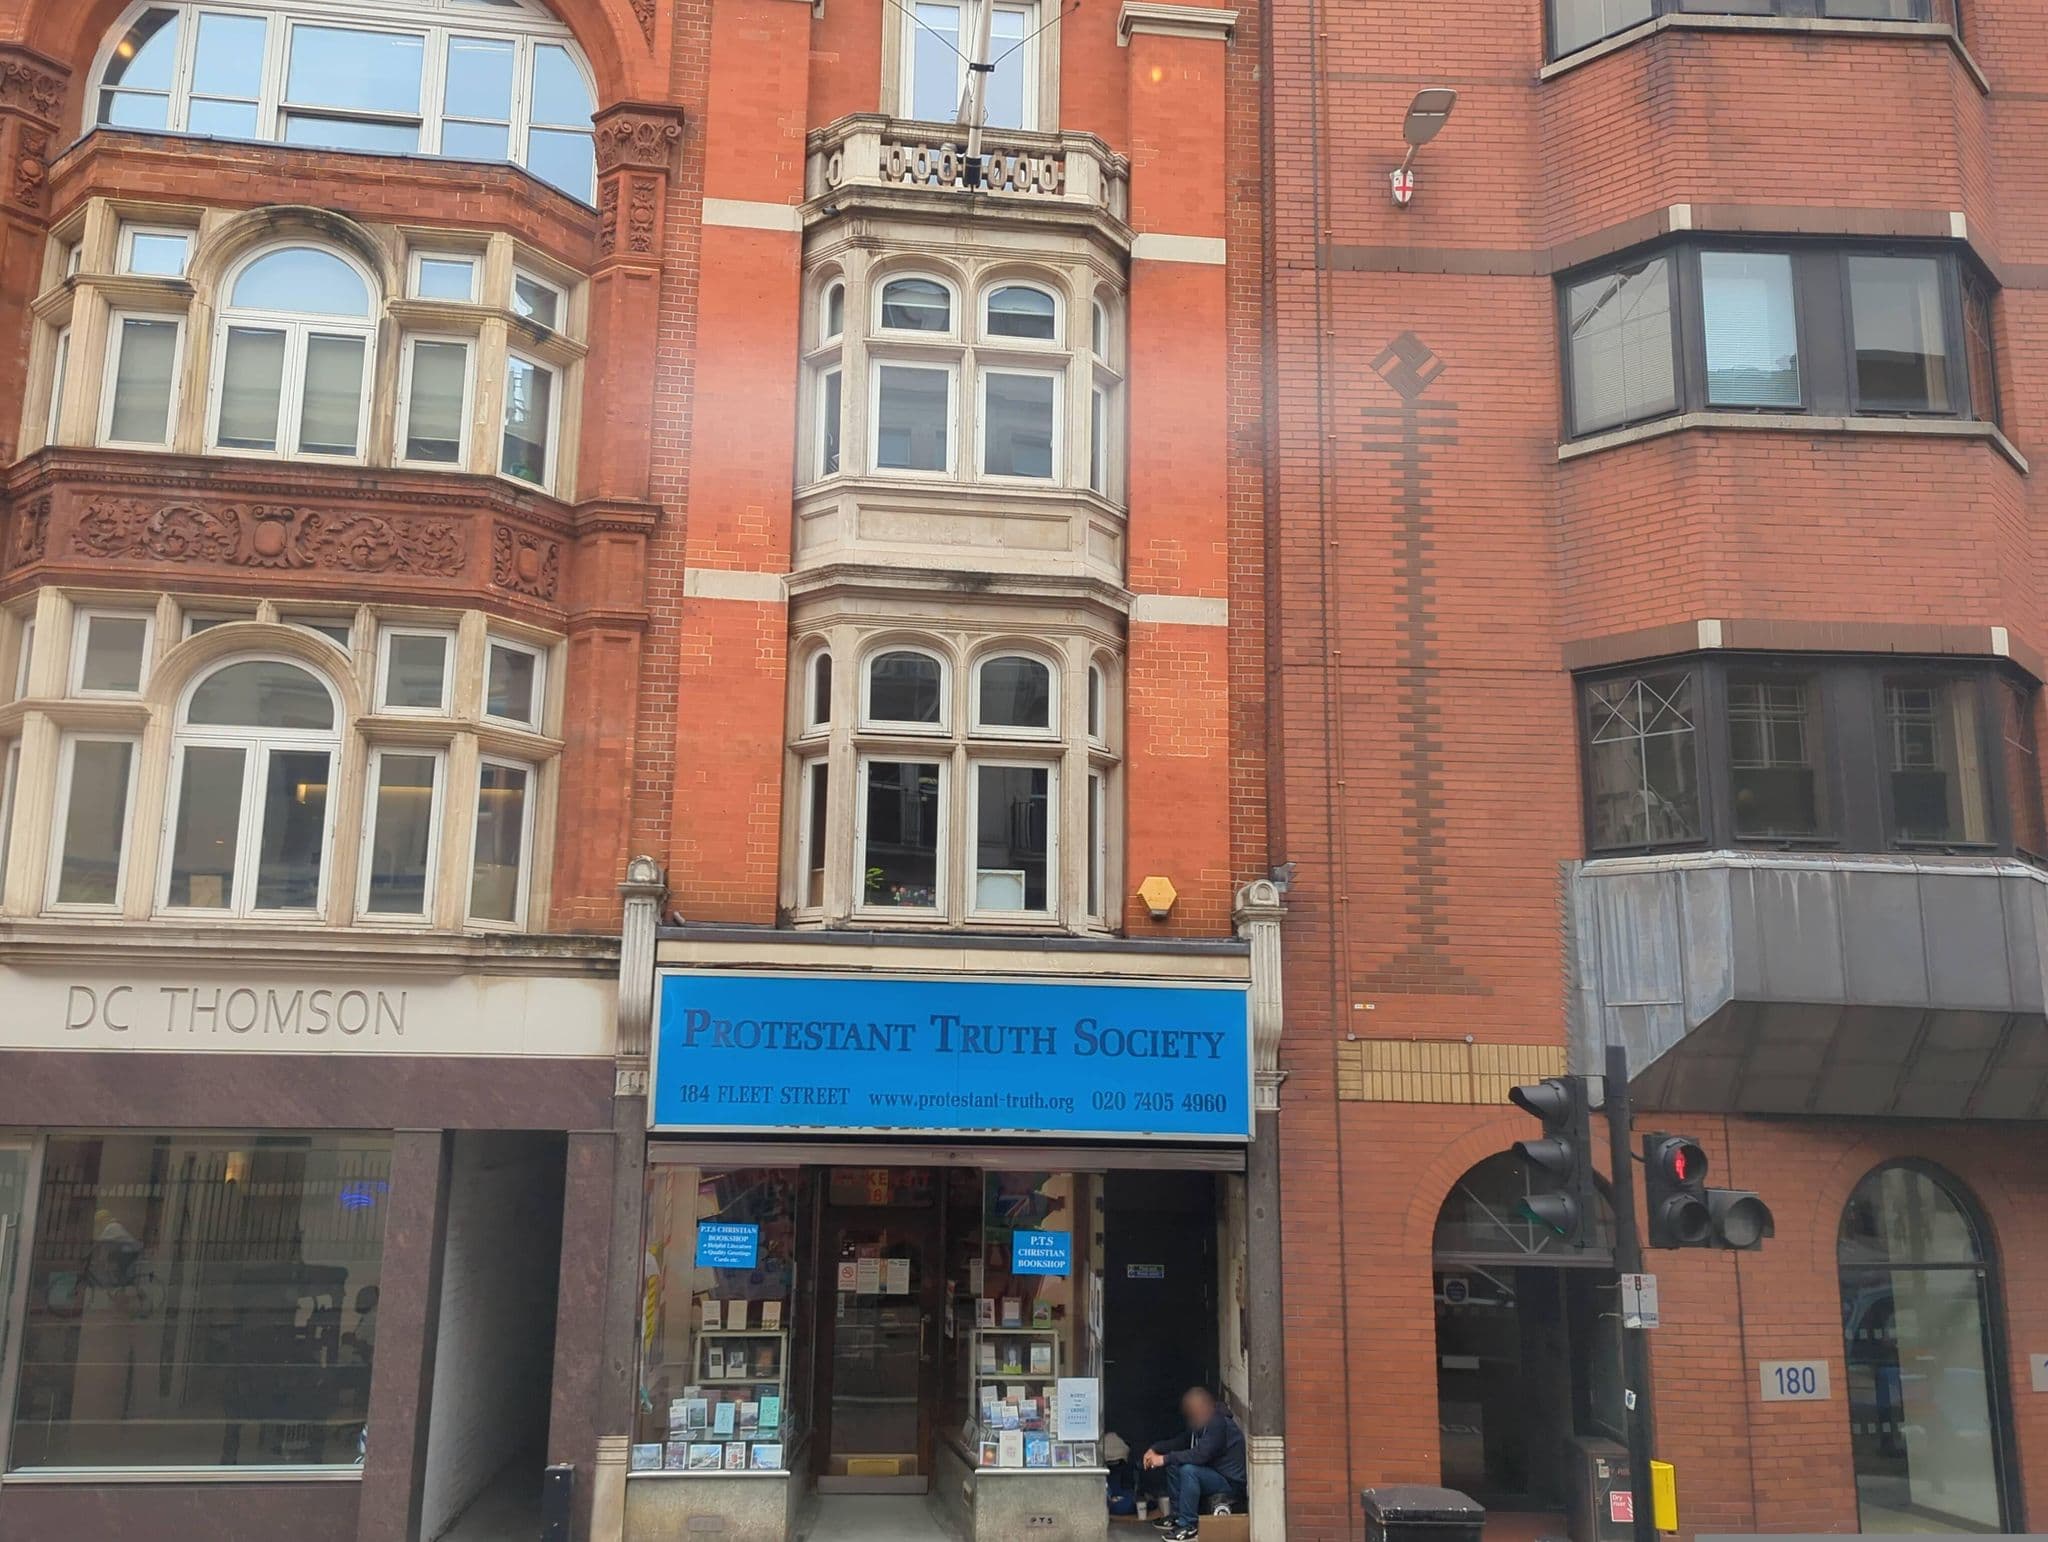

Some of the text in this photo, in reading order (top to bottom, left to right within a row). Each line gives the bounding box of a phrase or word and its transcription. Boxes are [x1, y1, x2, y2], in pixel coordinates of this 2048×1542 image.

[65, 985, 407, 1035] DC THOMSON
[681, 1008, 1226, 1059] PROTESTANT TRUTH SOCIETY
[680, 1084, 1227, 1113] 184 FLEET STREET www.protestant-truth.org 020 7405 4960
[717, 1226, 757, 1234] CHRISTIAN
[1018, 1249, 1065, 1257] CHRISTIAN
[1018, 1260, 1065, 1268] BOOKSHOP
[1775, 1366, 1816, 1395] 180
[1612, 1494, 1623, 1502] Dry
